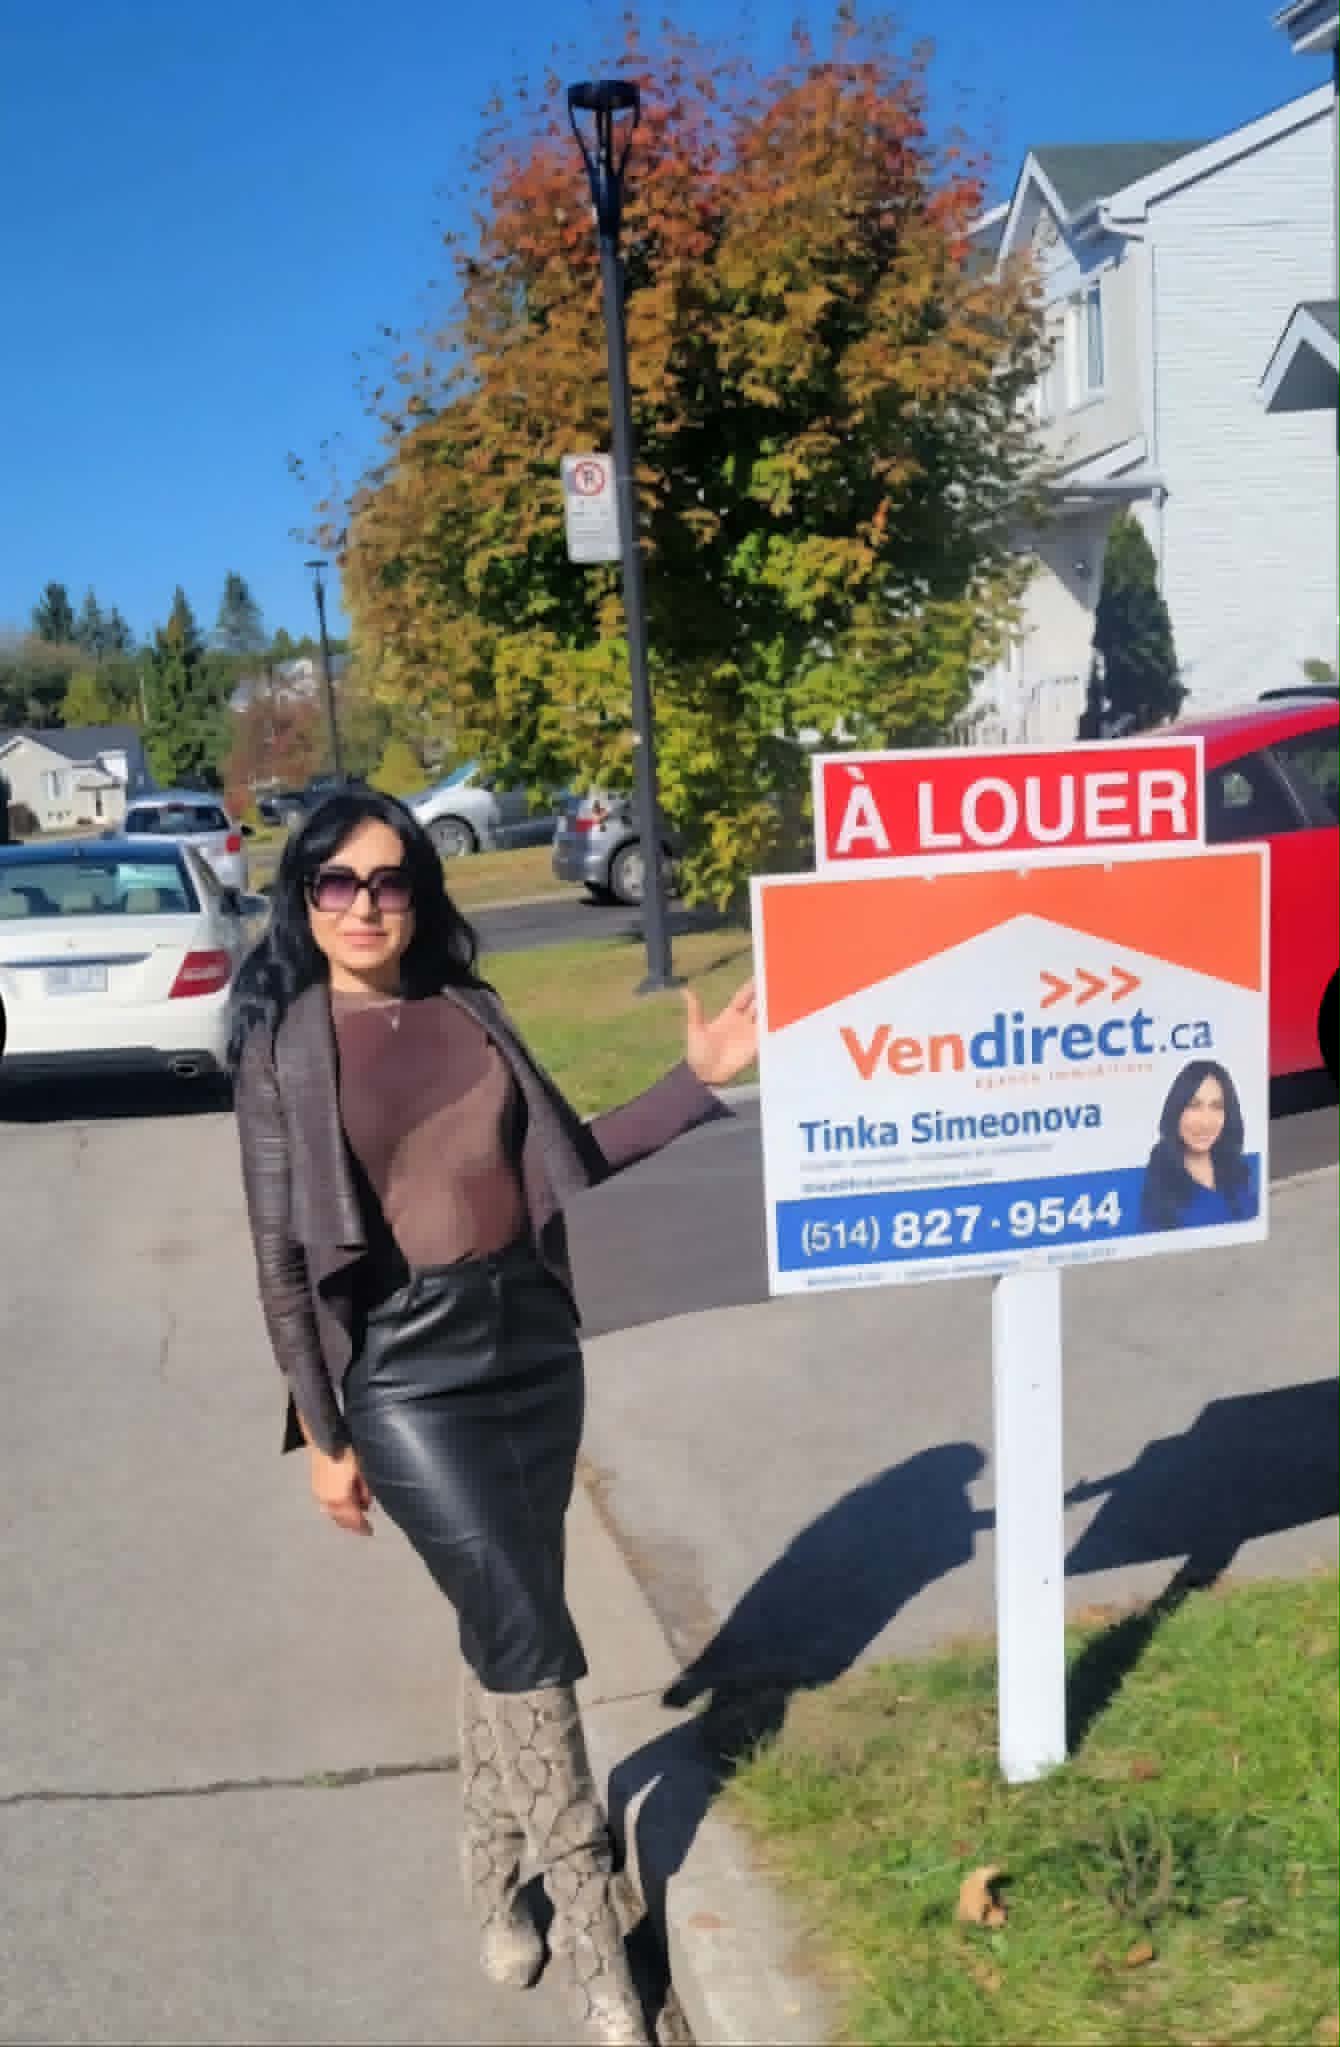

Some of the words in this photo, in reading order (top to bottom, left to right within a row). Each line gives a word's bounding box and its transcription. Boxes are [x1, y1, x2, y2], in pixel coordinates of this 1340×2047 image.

[835, 765, 891, 854] À
[918, 769, 1189, 848] LOUER
[840, 1007, 1213, 1081] Vendirect.ca
[798, 1115, 899, 1153] Tinka
[911, 1102, 1102, 1144] Simeonova
[801, 1214, 881, 1257] (514)
